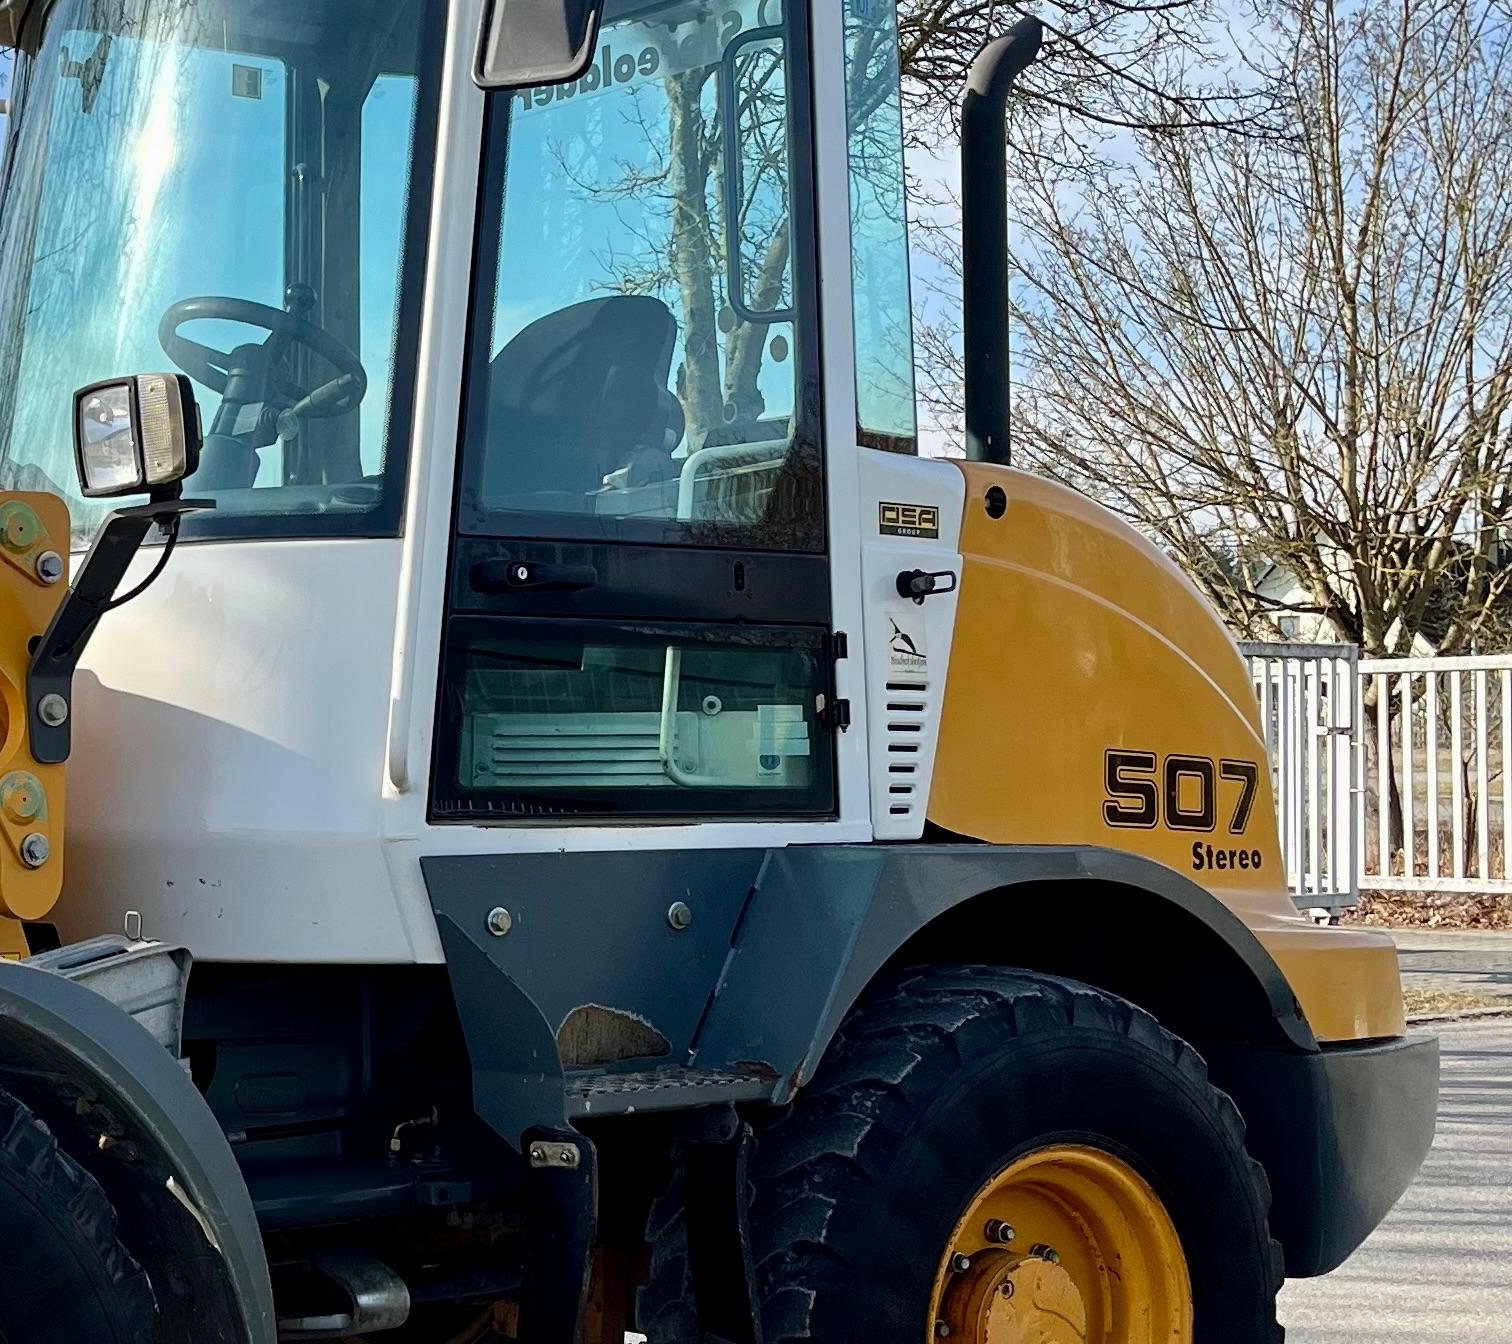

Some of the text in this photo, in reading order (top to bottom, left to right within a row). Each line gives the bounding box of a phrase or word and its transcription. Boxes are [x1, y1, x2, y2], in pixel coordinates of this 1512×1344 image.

[897, 528, 920, 536] GROUP
[1103, 748, 1259, 835] 507
[1192, 841, 1262, 871] Stereo
